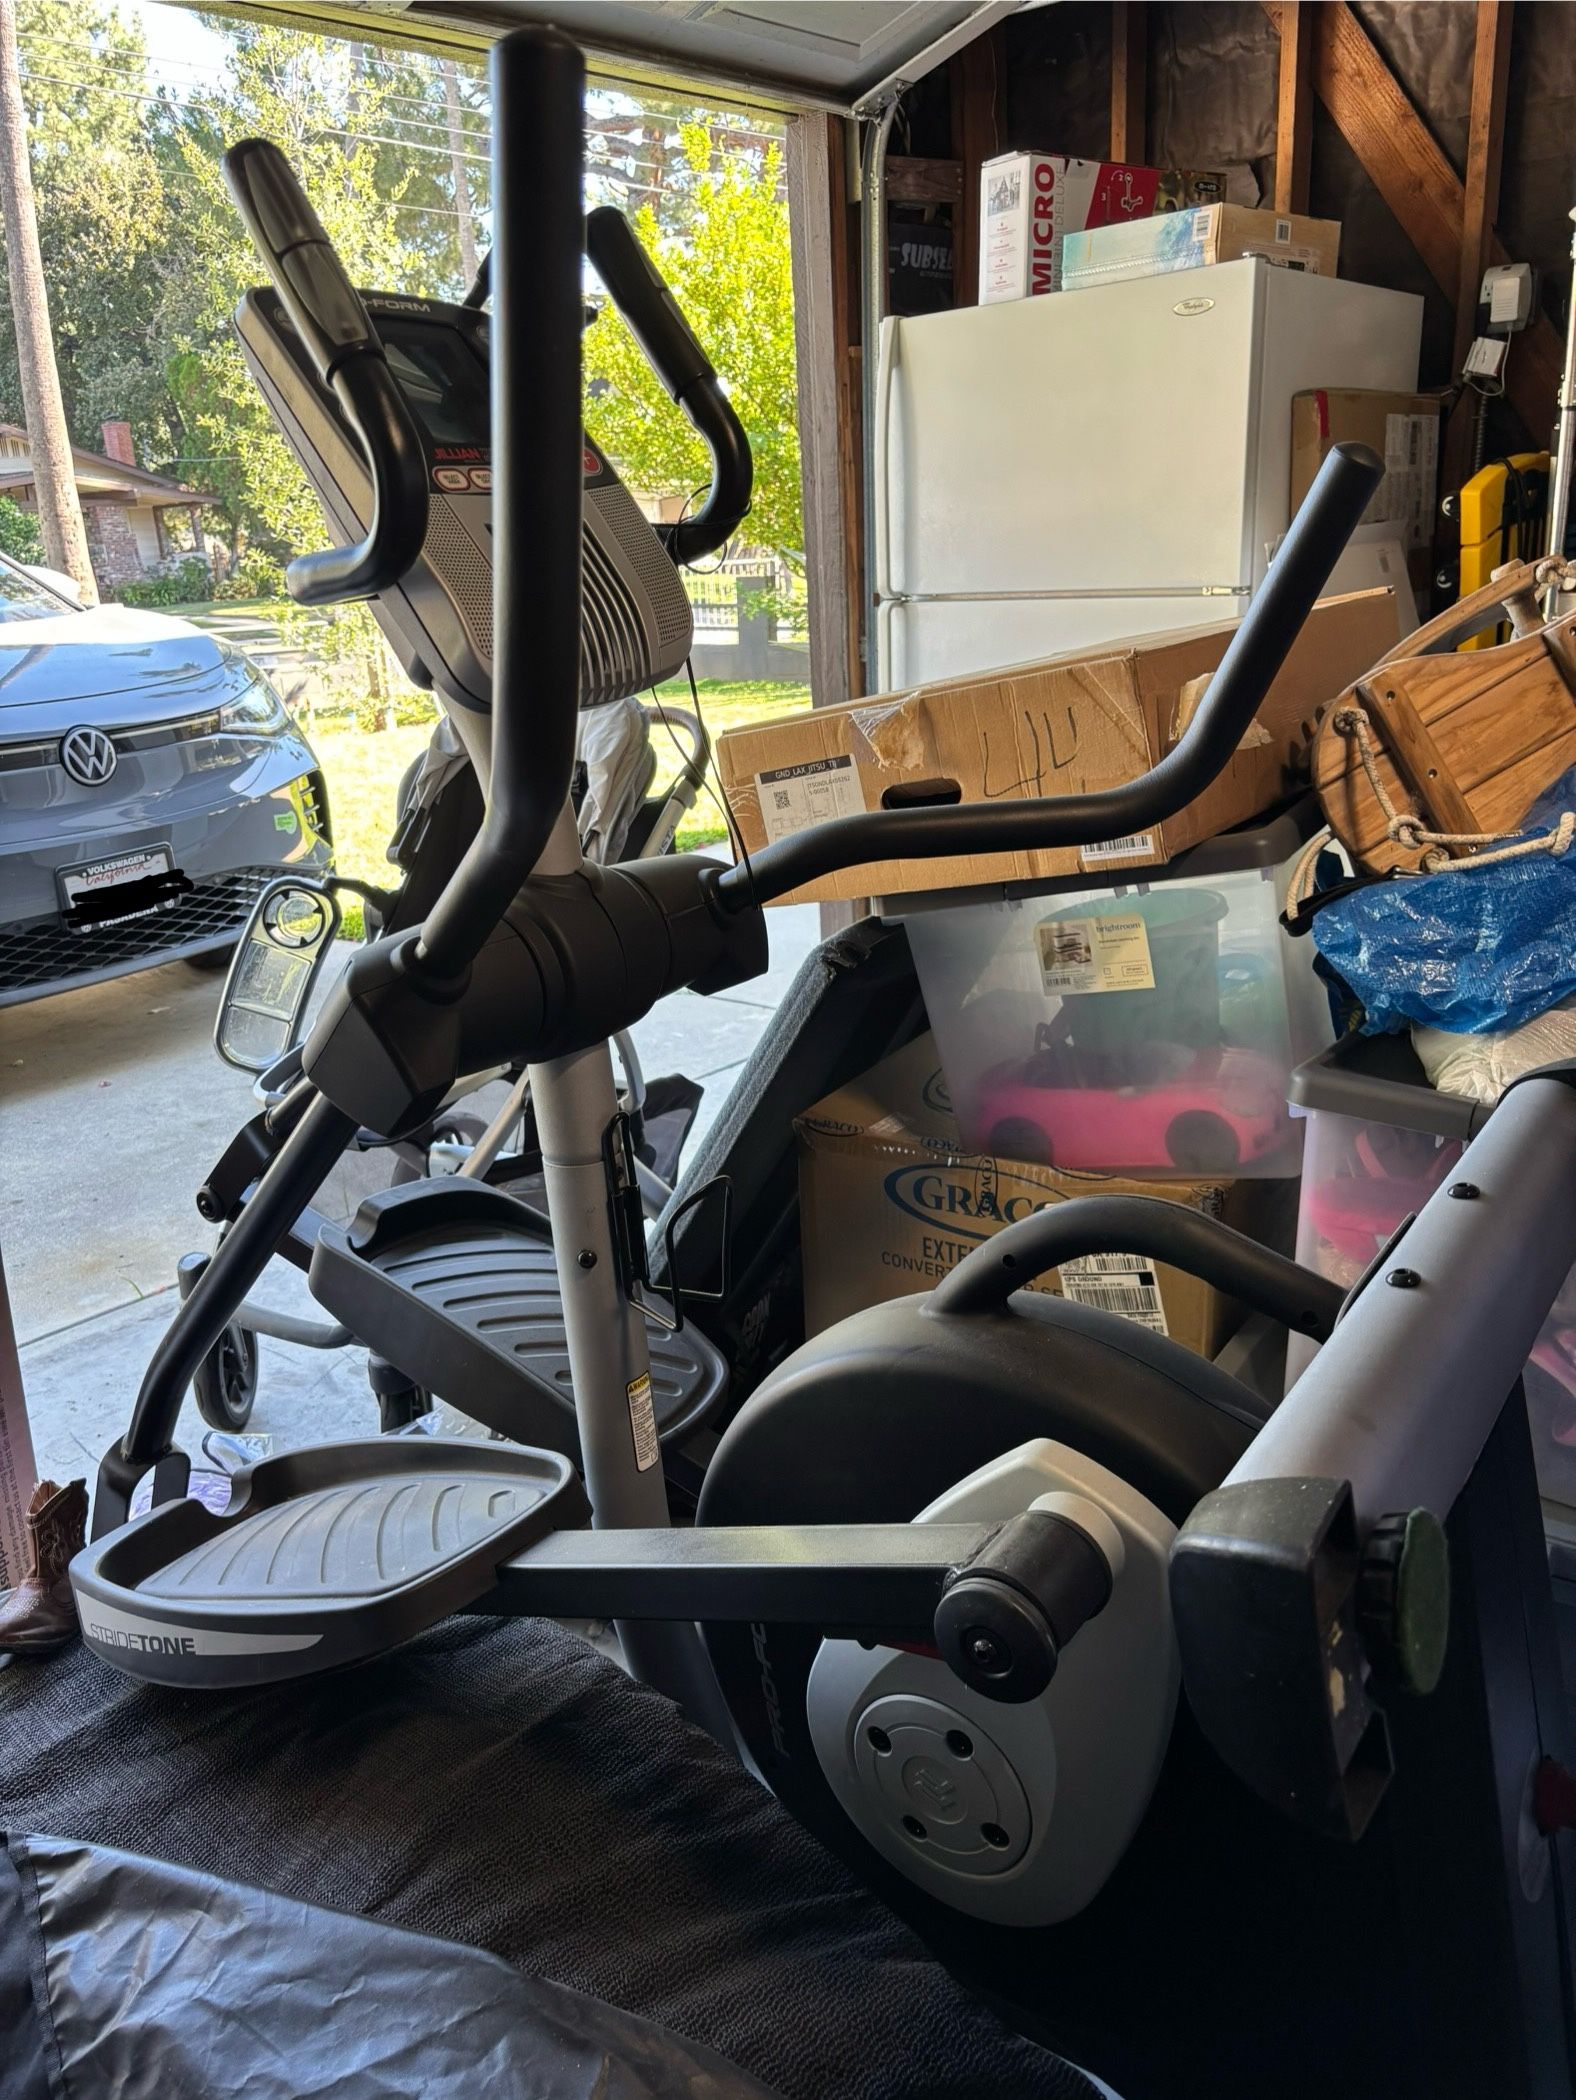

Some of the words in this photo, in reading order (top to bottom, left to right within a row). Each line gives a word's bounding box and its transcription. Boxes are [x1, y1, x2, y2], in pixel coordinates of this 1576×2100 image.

[1054, 168, 1065, 226] DELUXE
[1032, 163, 1055, 296] MICRO
[361, 297, 431, 313] -FORM
[87, 854, 146, 876] VOLKSWAGEN
[923, 1236, 975, 1263] EXTE
[90, 1623, 196, 1653] STRIDETONE
